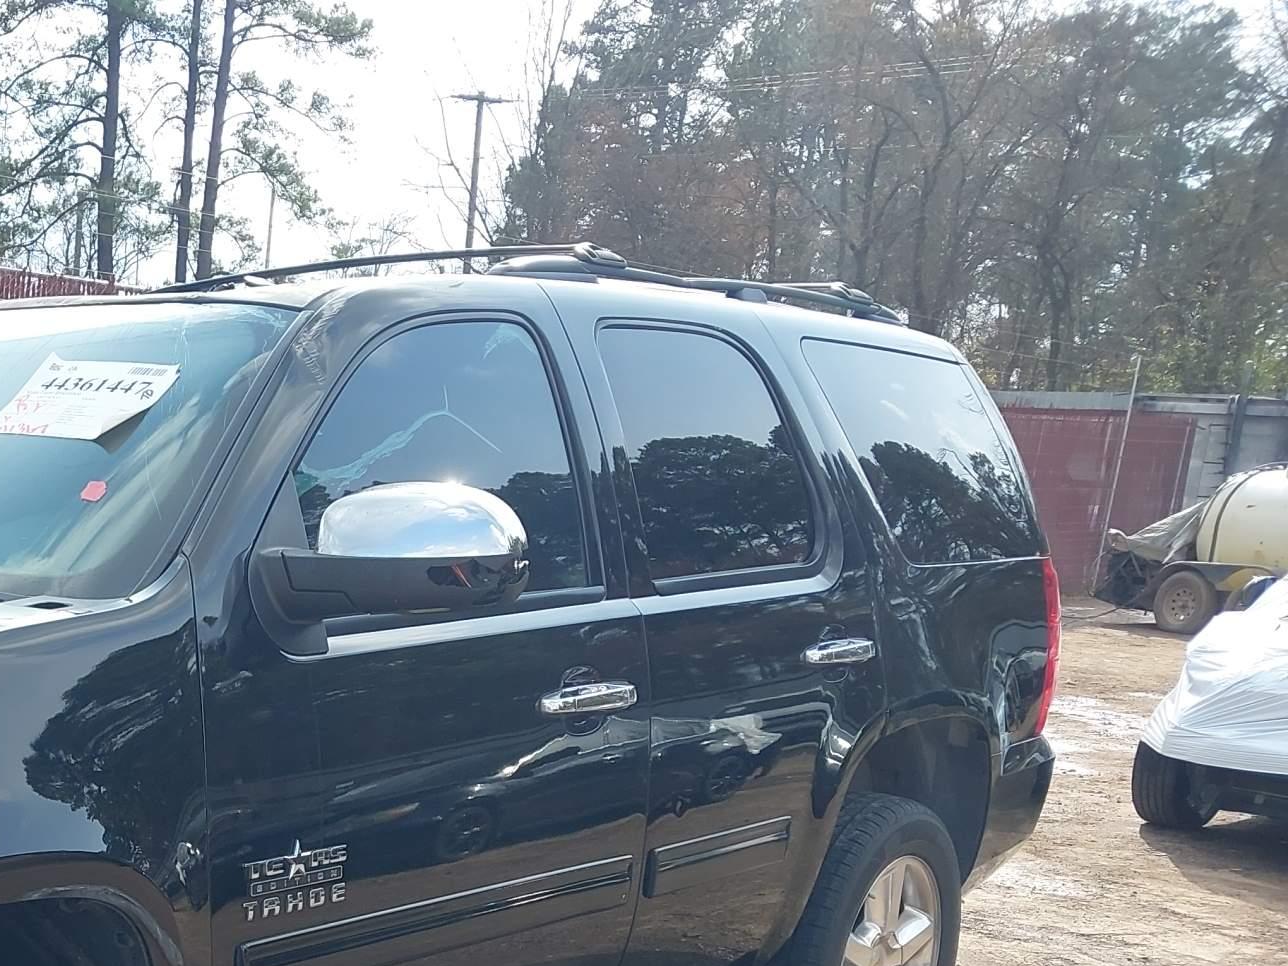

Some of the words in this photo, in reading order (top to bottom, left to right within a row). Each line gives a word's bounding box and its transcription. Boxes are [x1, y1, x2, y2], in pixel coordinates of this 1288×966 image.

[41, 377, 153, 395] 44361447
[256, 869, 338, 892] EDITION
[242, 882, 346, 921] TAHOE
